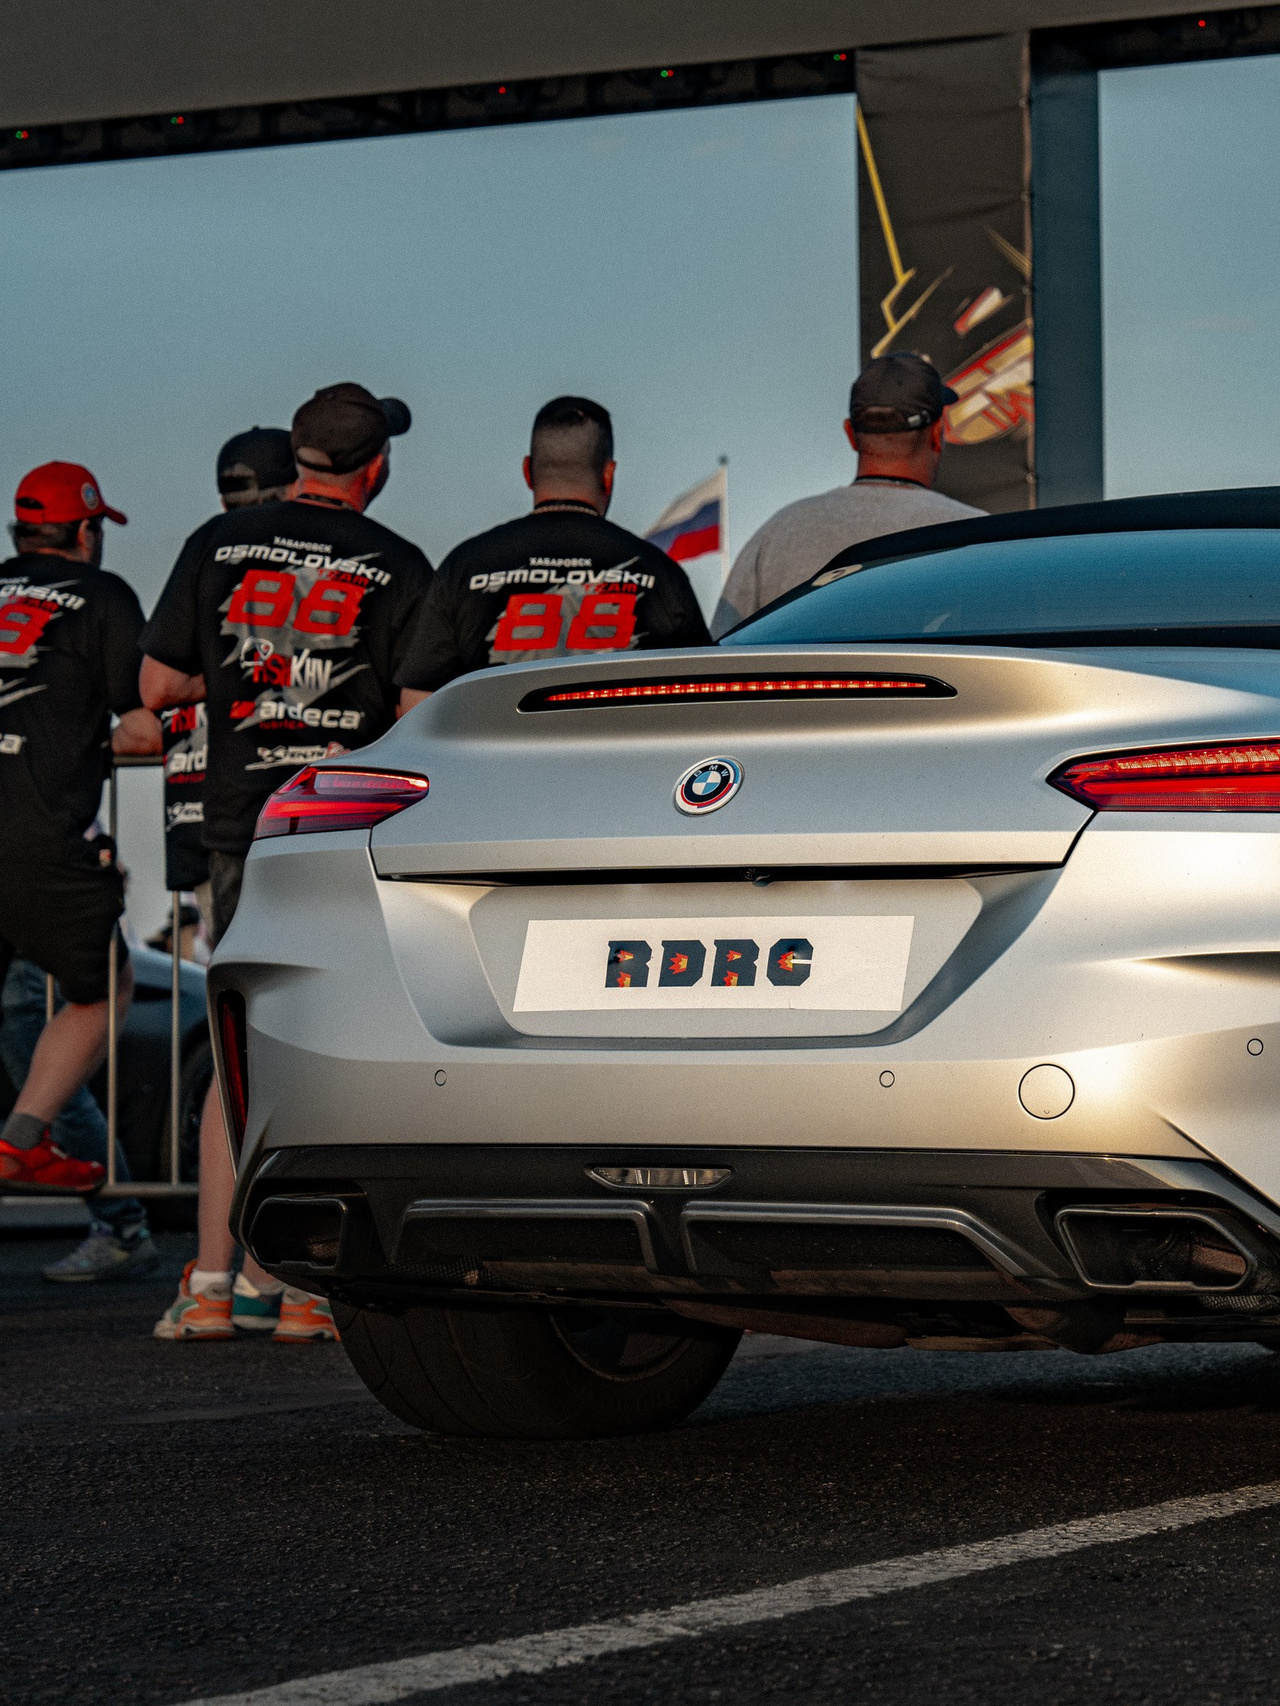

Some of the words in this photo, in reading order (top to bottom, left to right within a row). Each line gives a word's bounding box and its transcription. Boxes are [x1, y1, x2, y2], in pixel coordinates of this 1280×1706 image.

[214, 545, 392, 586] OSMOLOVSKII
[469, 569, 656, 590] OSMOLOVSKII
[227, 569, 367, 635] 88
[493, 593, 638, 650] 88
[259, 701, 362, 729] ardeca
[694, 764, 729, 777] BMW
[605, 938, 814, 988] RDRC
